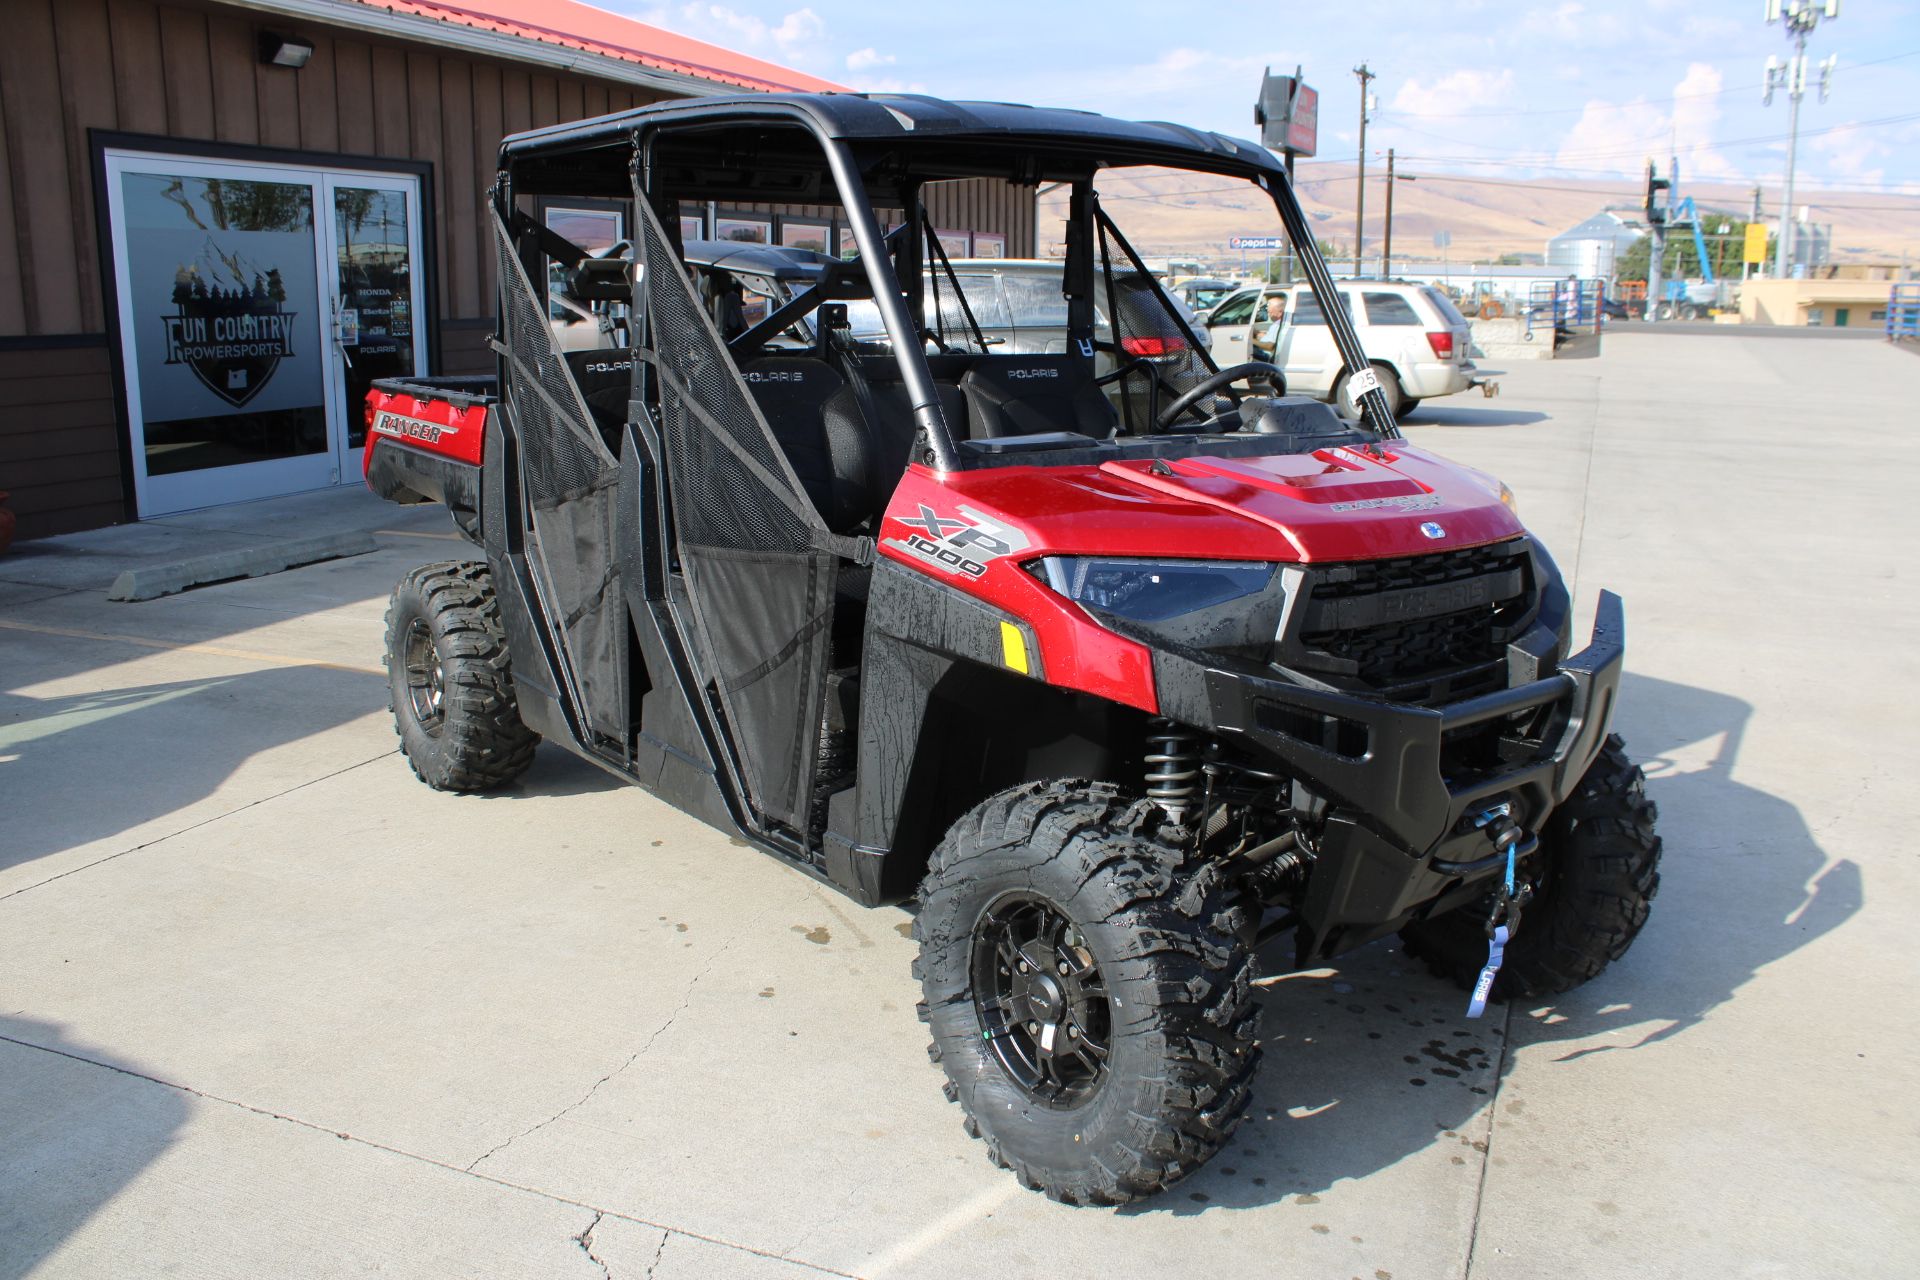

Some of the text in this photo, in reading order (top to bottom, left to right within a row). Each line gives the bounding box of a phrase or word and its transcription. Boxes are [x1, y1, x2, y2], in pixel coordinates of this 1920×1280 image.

[1241, 238, 1267, 249] pepsi
[360, 288, 392, 296] HONDA
[166, 317, 208, 362] FUN
[214, 314, 293, 355] COUNTRY
[184, 342, 282, 360] POWERSPORTS
[360, 345, 397, 354] POLARIS
[585, 361, 631, 373] POLAR
[1007, 368, 1058, 379] POLARIS
[380, 414, 441, 443] RANGER
[891, 503, 1012, 556] XP
[906, 534, 988, 577] 1000
